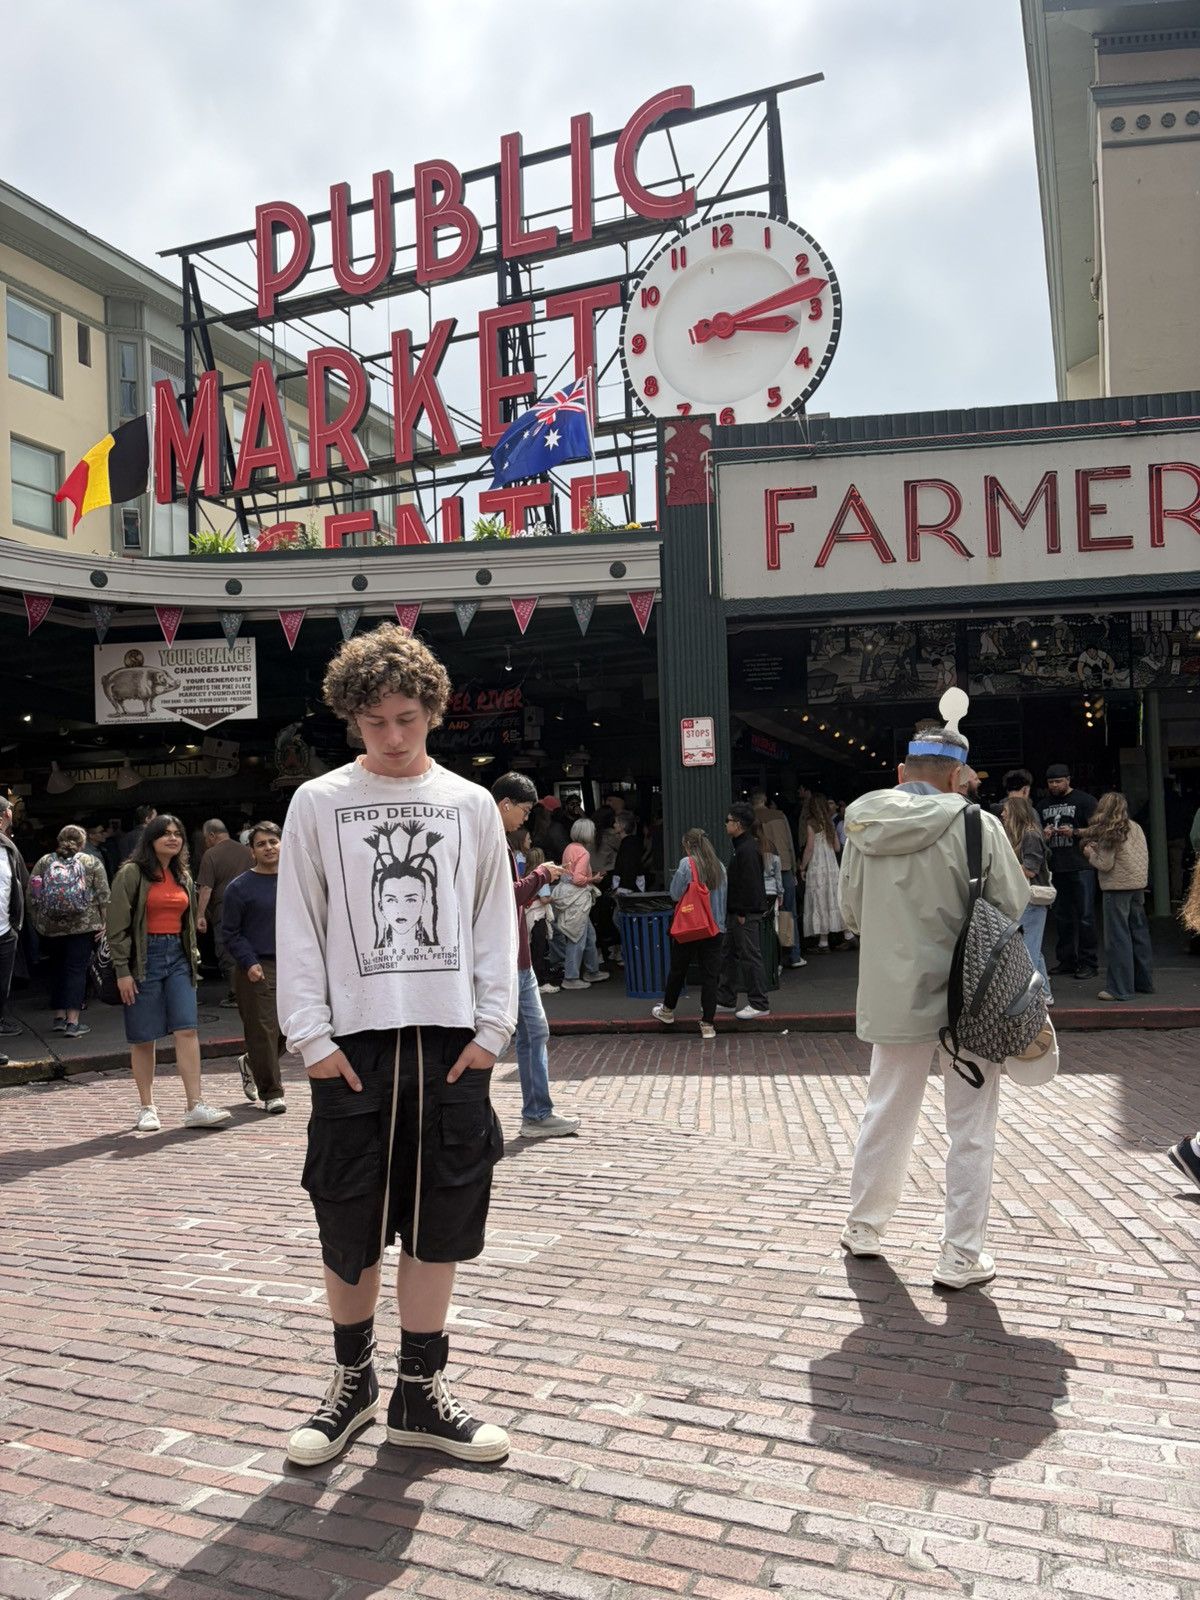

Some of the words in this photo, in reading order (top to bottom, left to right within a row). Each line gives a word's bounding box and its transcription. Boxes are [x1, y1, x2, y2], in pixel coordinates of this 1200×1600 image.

[255, 84, 697, 319] PUBLIC
[712, 224, 734, 249] 12
[764, 226, 772, 250] 1
[671, 246, 687, 271] 11
[795, 253, 811, 276] 2
[641, 286, 661, 309] 10
[808, 297, 823, 321] 3
[631, 333, 647, 355] 9
[794, 346, 813, 369] 4
[154, 281, 623, 504] MARKET
[643, 375, 660, 397] 8
[767, 386, 783, 408] 5
[719, 407, 736, 426] 6
[763, 461, 1200, 571] FARMER
[158, 648, 195, 667] YOUR
[196, 645, 252, 665] CHANGE
[174, 665, 219, 674] CHANGES
[221, 664, 252, 673] LIVES!
[206, 676, 252, 684] GENEROSITY
[477, 687, 523, 711] RIVER
[176, 707, 211, 715] DONATE
[211, 706, 238, 714] HERE!
[448, 720, 471, 730] AND
[683, 720, 693, 728] NO
[686, 729, 710, 738] STOPS
[341, 809, 379, 824] ERD
[386, 806, 456, 821] DELUXE
[396, 954, 403, 962] OF
[432, 952, 458, 960] FETISH
